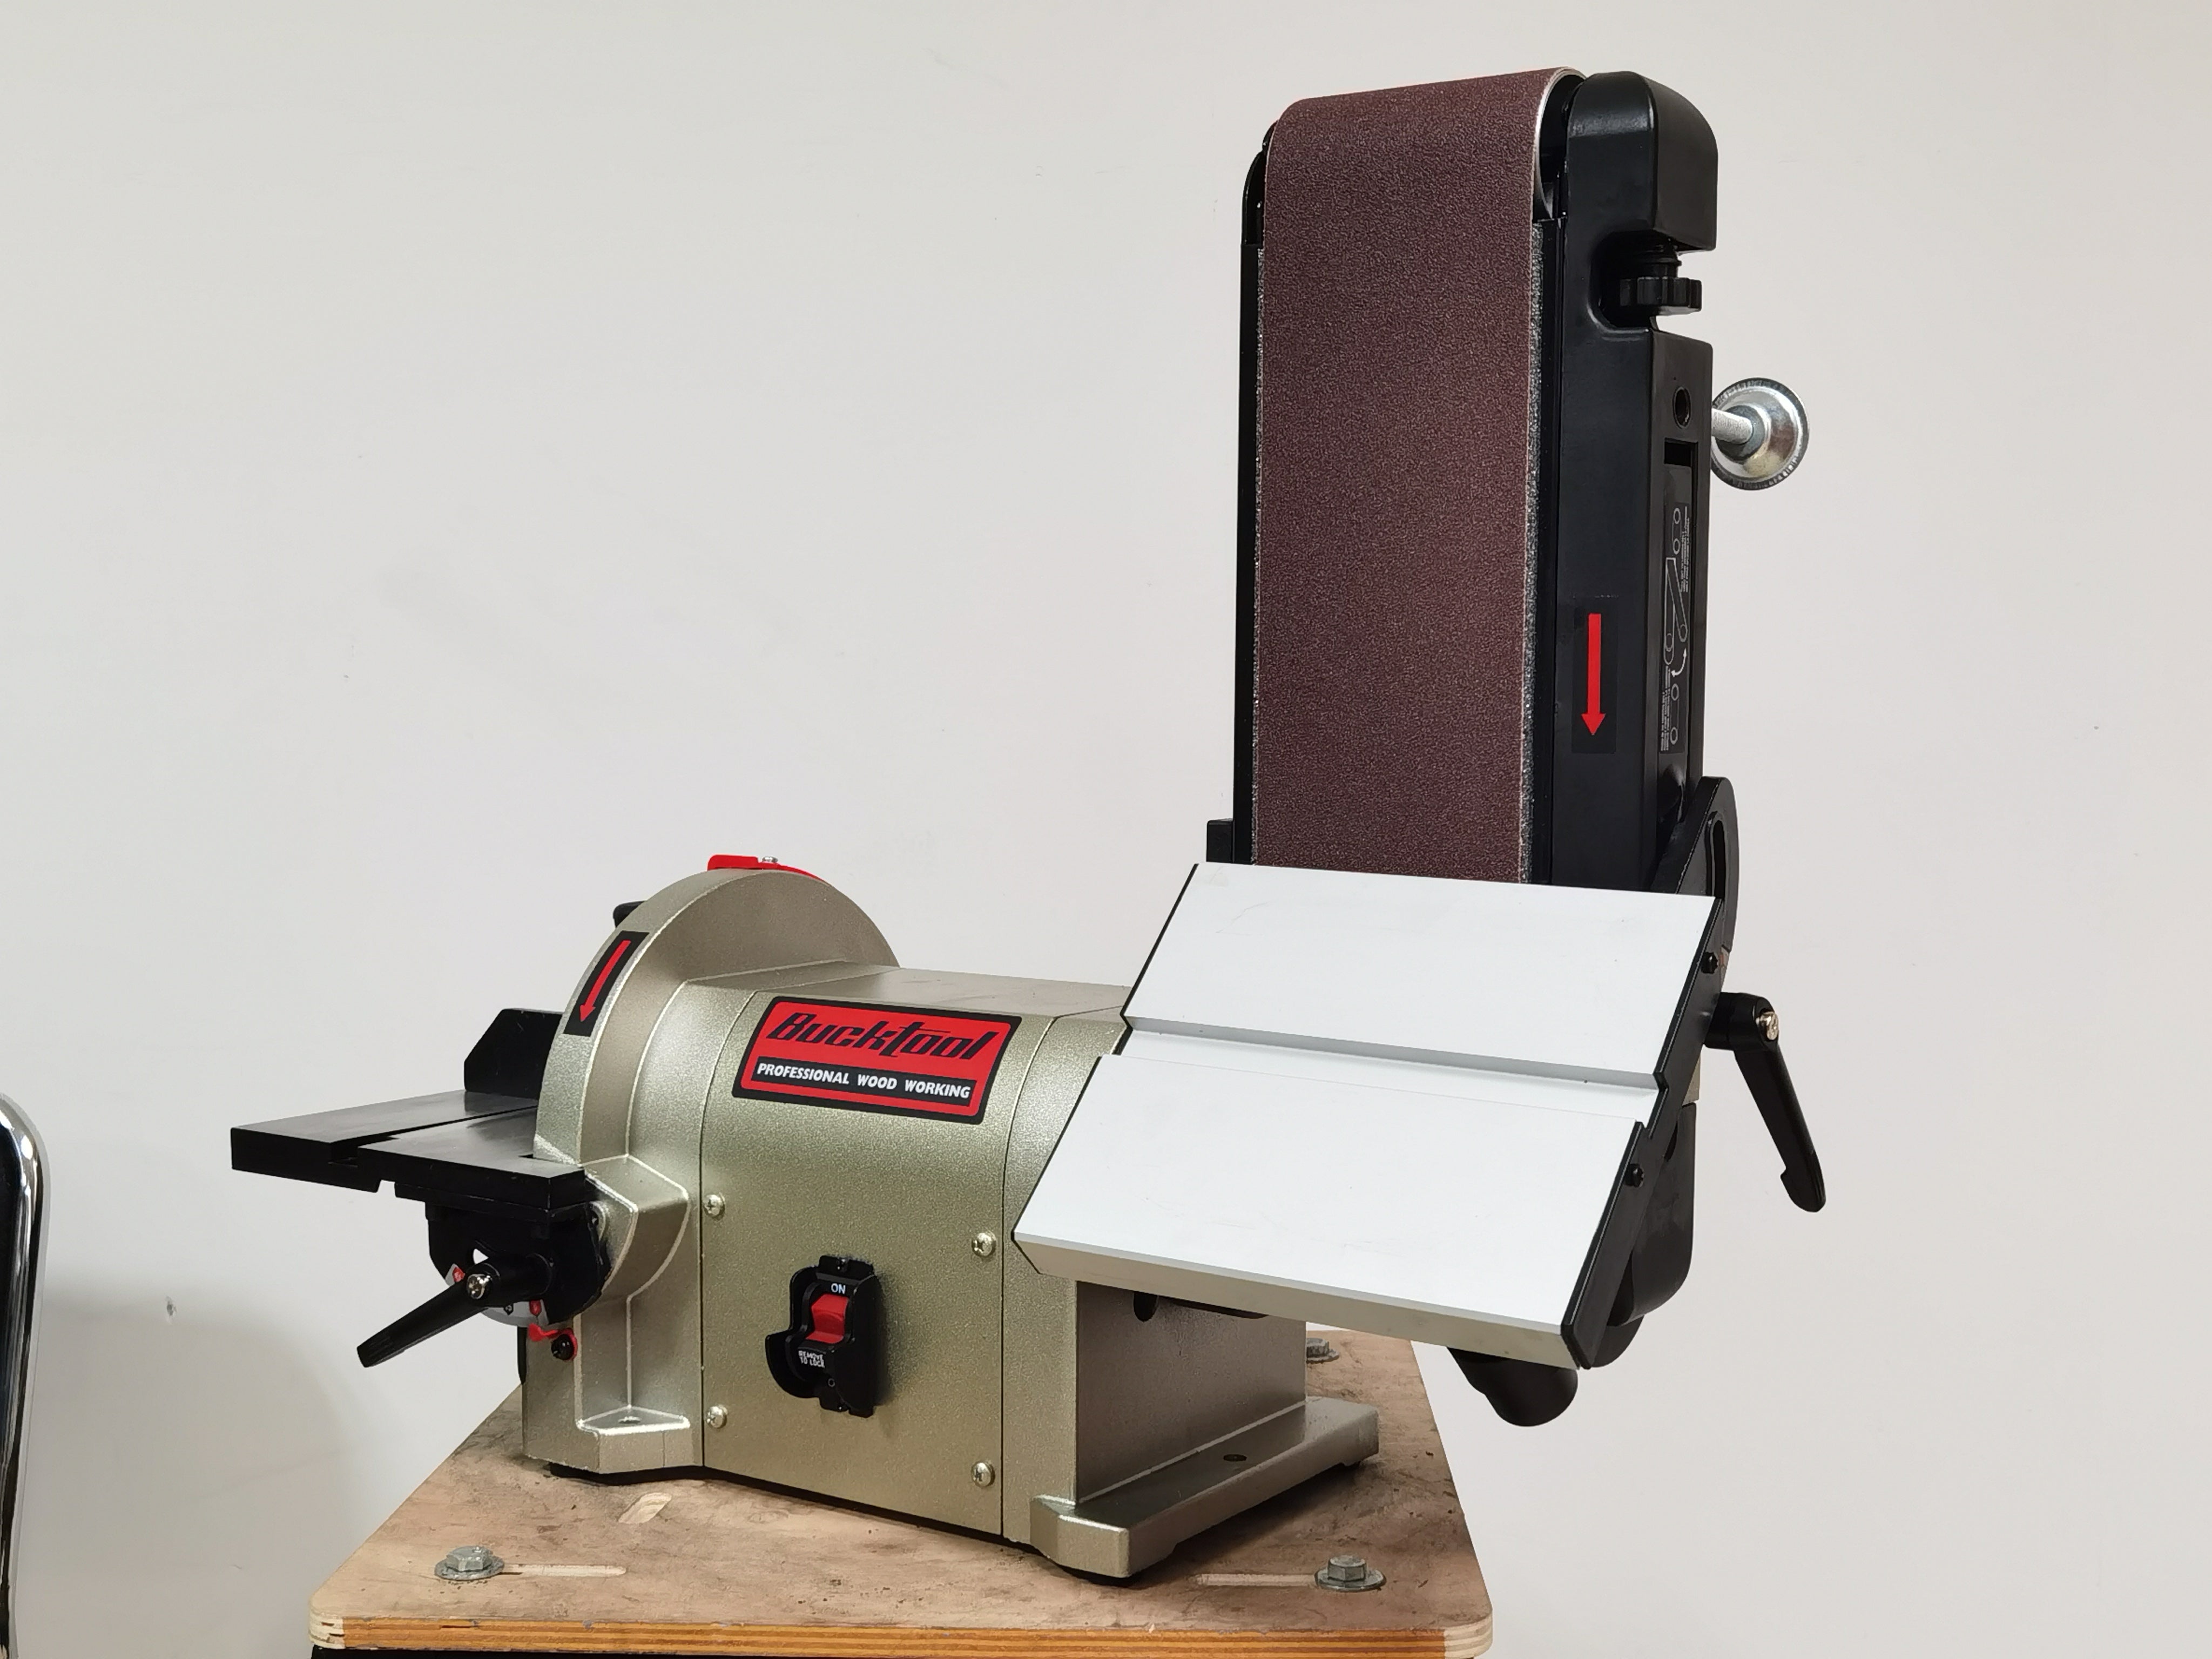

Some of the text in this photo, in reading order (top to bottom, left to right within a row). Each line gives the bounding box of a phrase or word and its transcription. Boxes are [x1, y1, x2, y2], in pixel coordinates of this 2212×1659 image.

[766, 1012, 999, 1059] Bucktool
[757, 1063, 971, 1098] PROFESSIONAL WOOD WORKING
[831, 1283, 846, 1294] ON
[798, 1350, 824, 1360] REMOVE
[810, 1358, 825, 1368] LOCK
